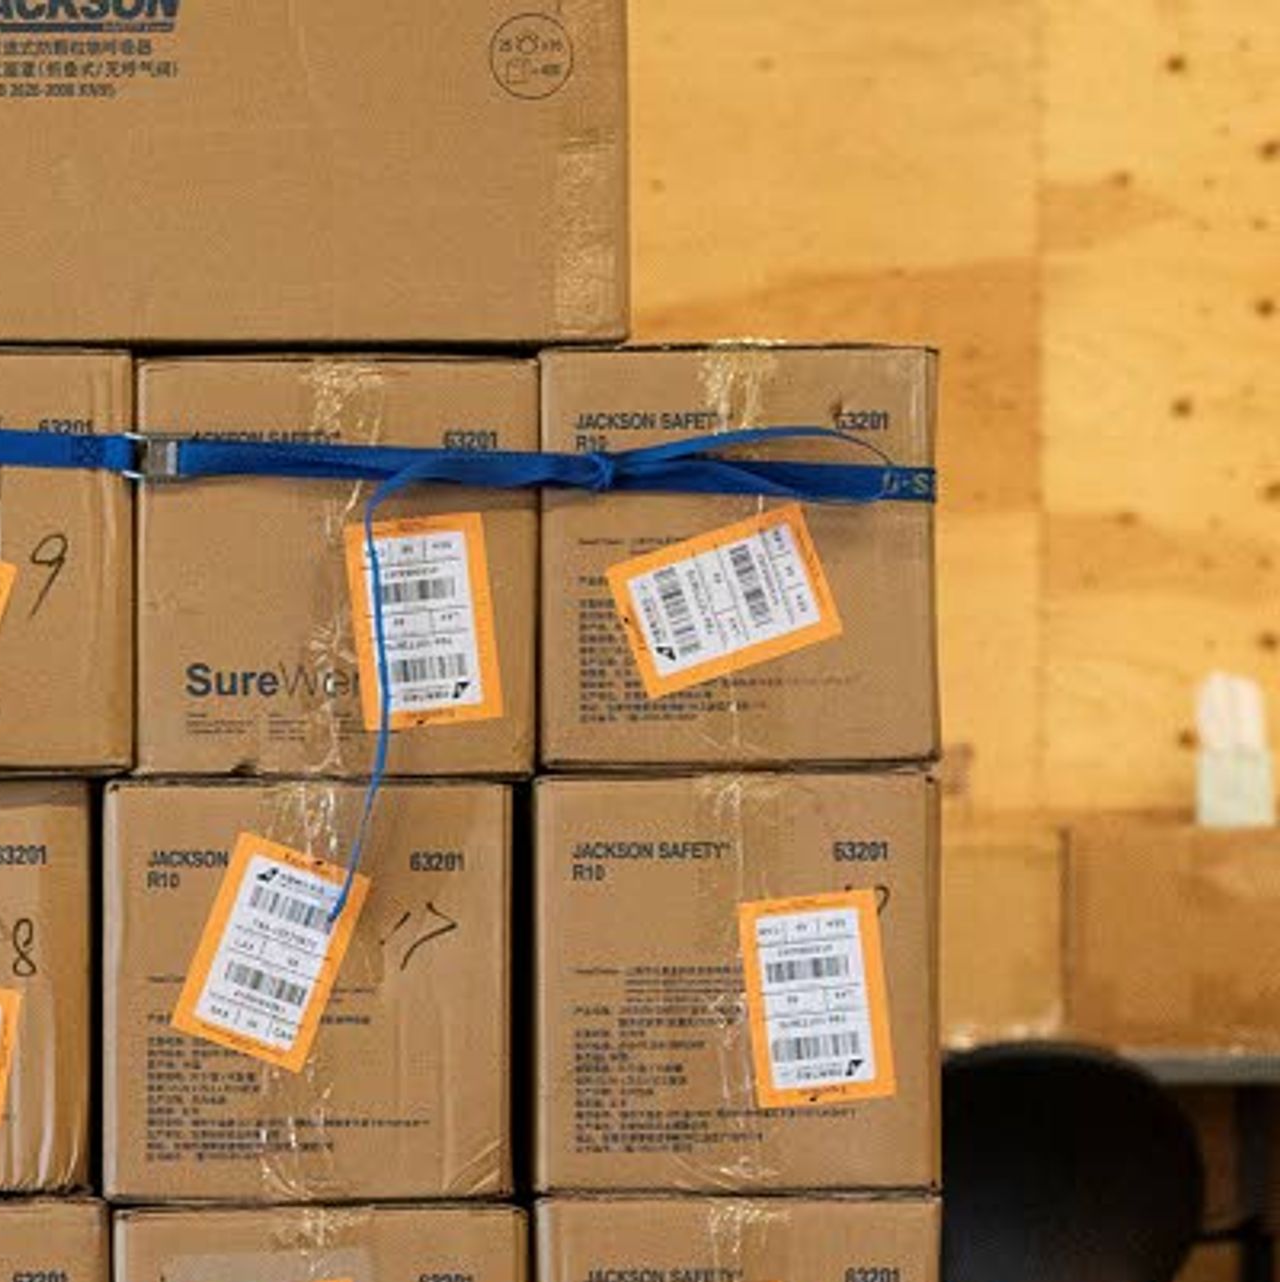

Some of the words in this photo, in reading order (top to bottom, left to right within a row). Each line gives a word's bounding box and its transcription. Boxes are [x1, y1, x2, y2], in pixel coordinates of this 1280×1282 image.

[576, 412, 655, 431] JACKSON
[32, 533, 69, 618] 9
[147, 851, 228, 868] JACKSON
[572, 842, 654, 860] JACKSON
[833, 841, 889, 862] 63201
[409, 852, 465, 872] 63201
[147, 873, 180, 890] R10
[572, 864, 606, 882] R10
[12, 917, 37, 977] 8
